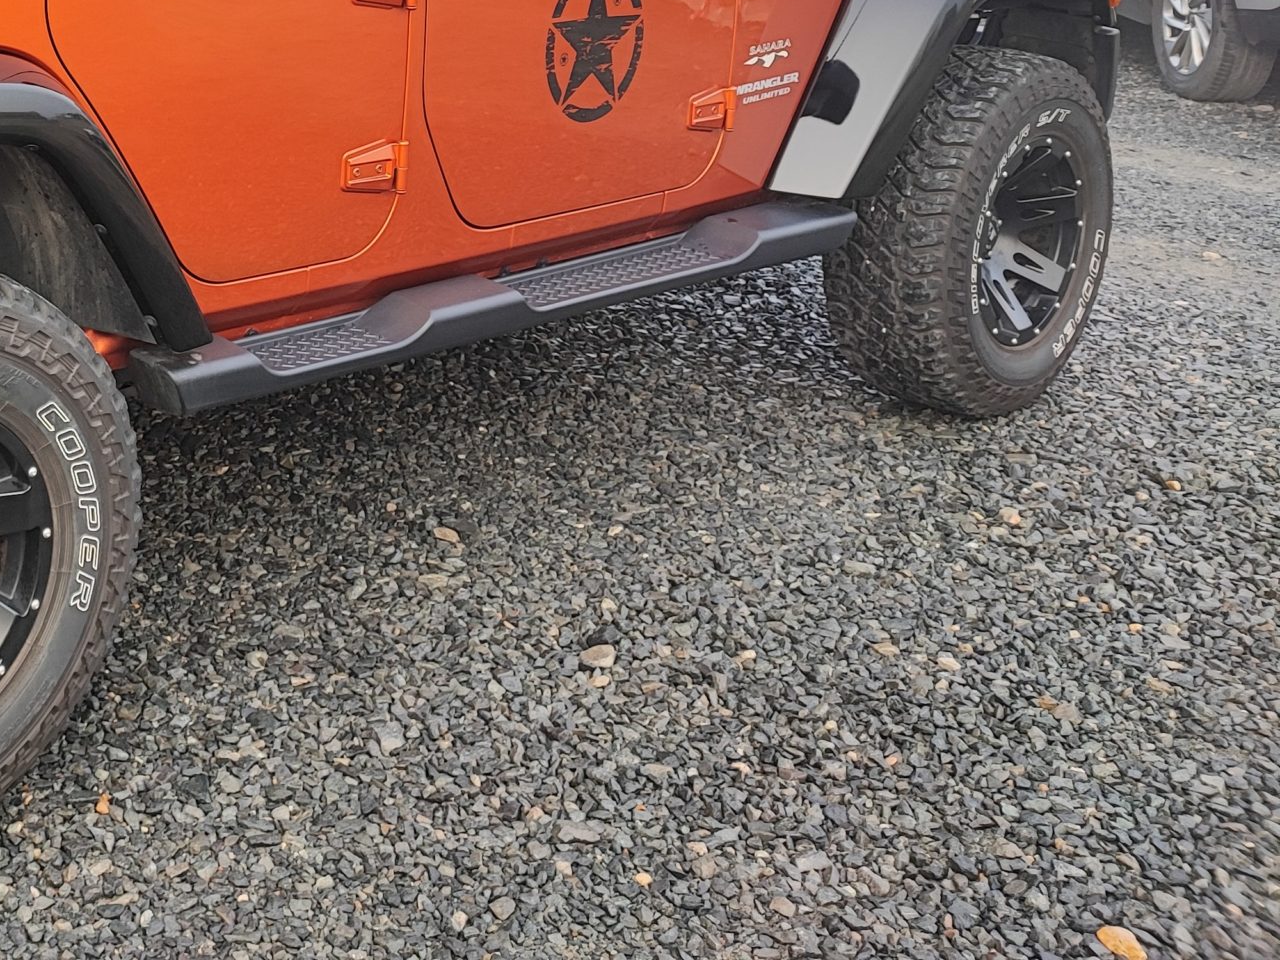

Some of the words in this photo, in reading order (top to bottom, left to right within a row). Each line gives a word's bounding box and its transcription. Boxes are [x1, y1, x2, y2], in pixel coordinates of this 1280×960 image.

[736, 72, 799, 96] WRANGLER
[748, 38, 792, 56] SAHARA
[742, 87, 791, 105] UNLIMITED
[970, 123, 1031, 315] DISCOVERER
[1036, 108, 1071, 128] S/T
[1053, 229, 1106, 359] COOPER
[36, 401, 100, 613] COOPER
